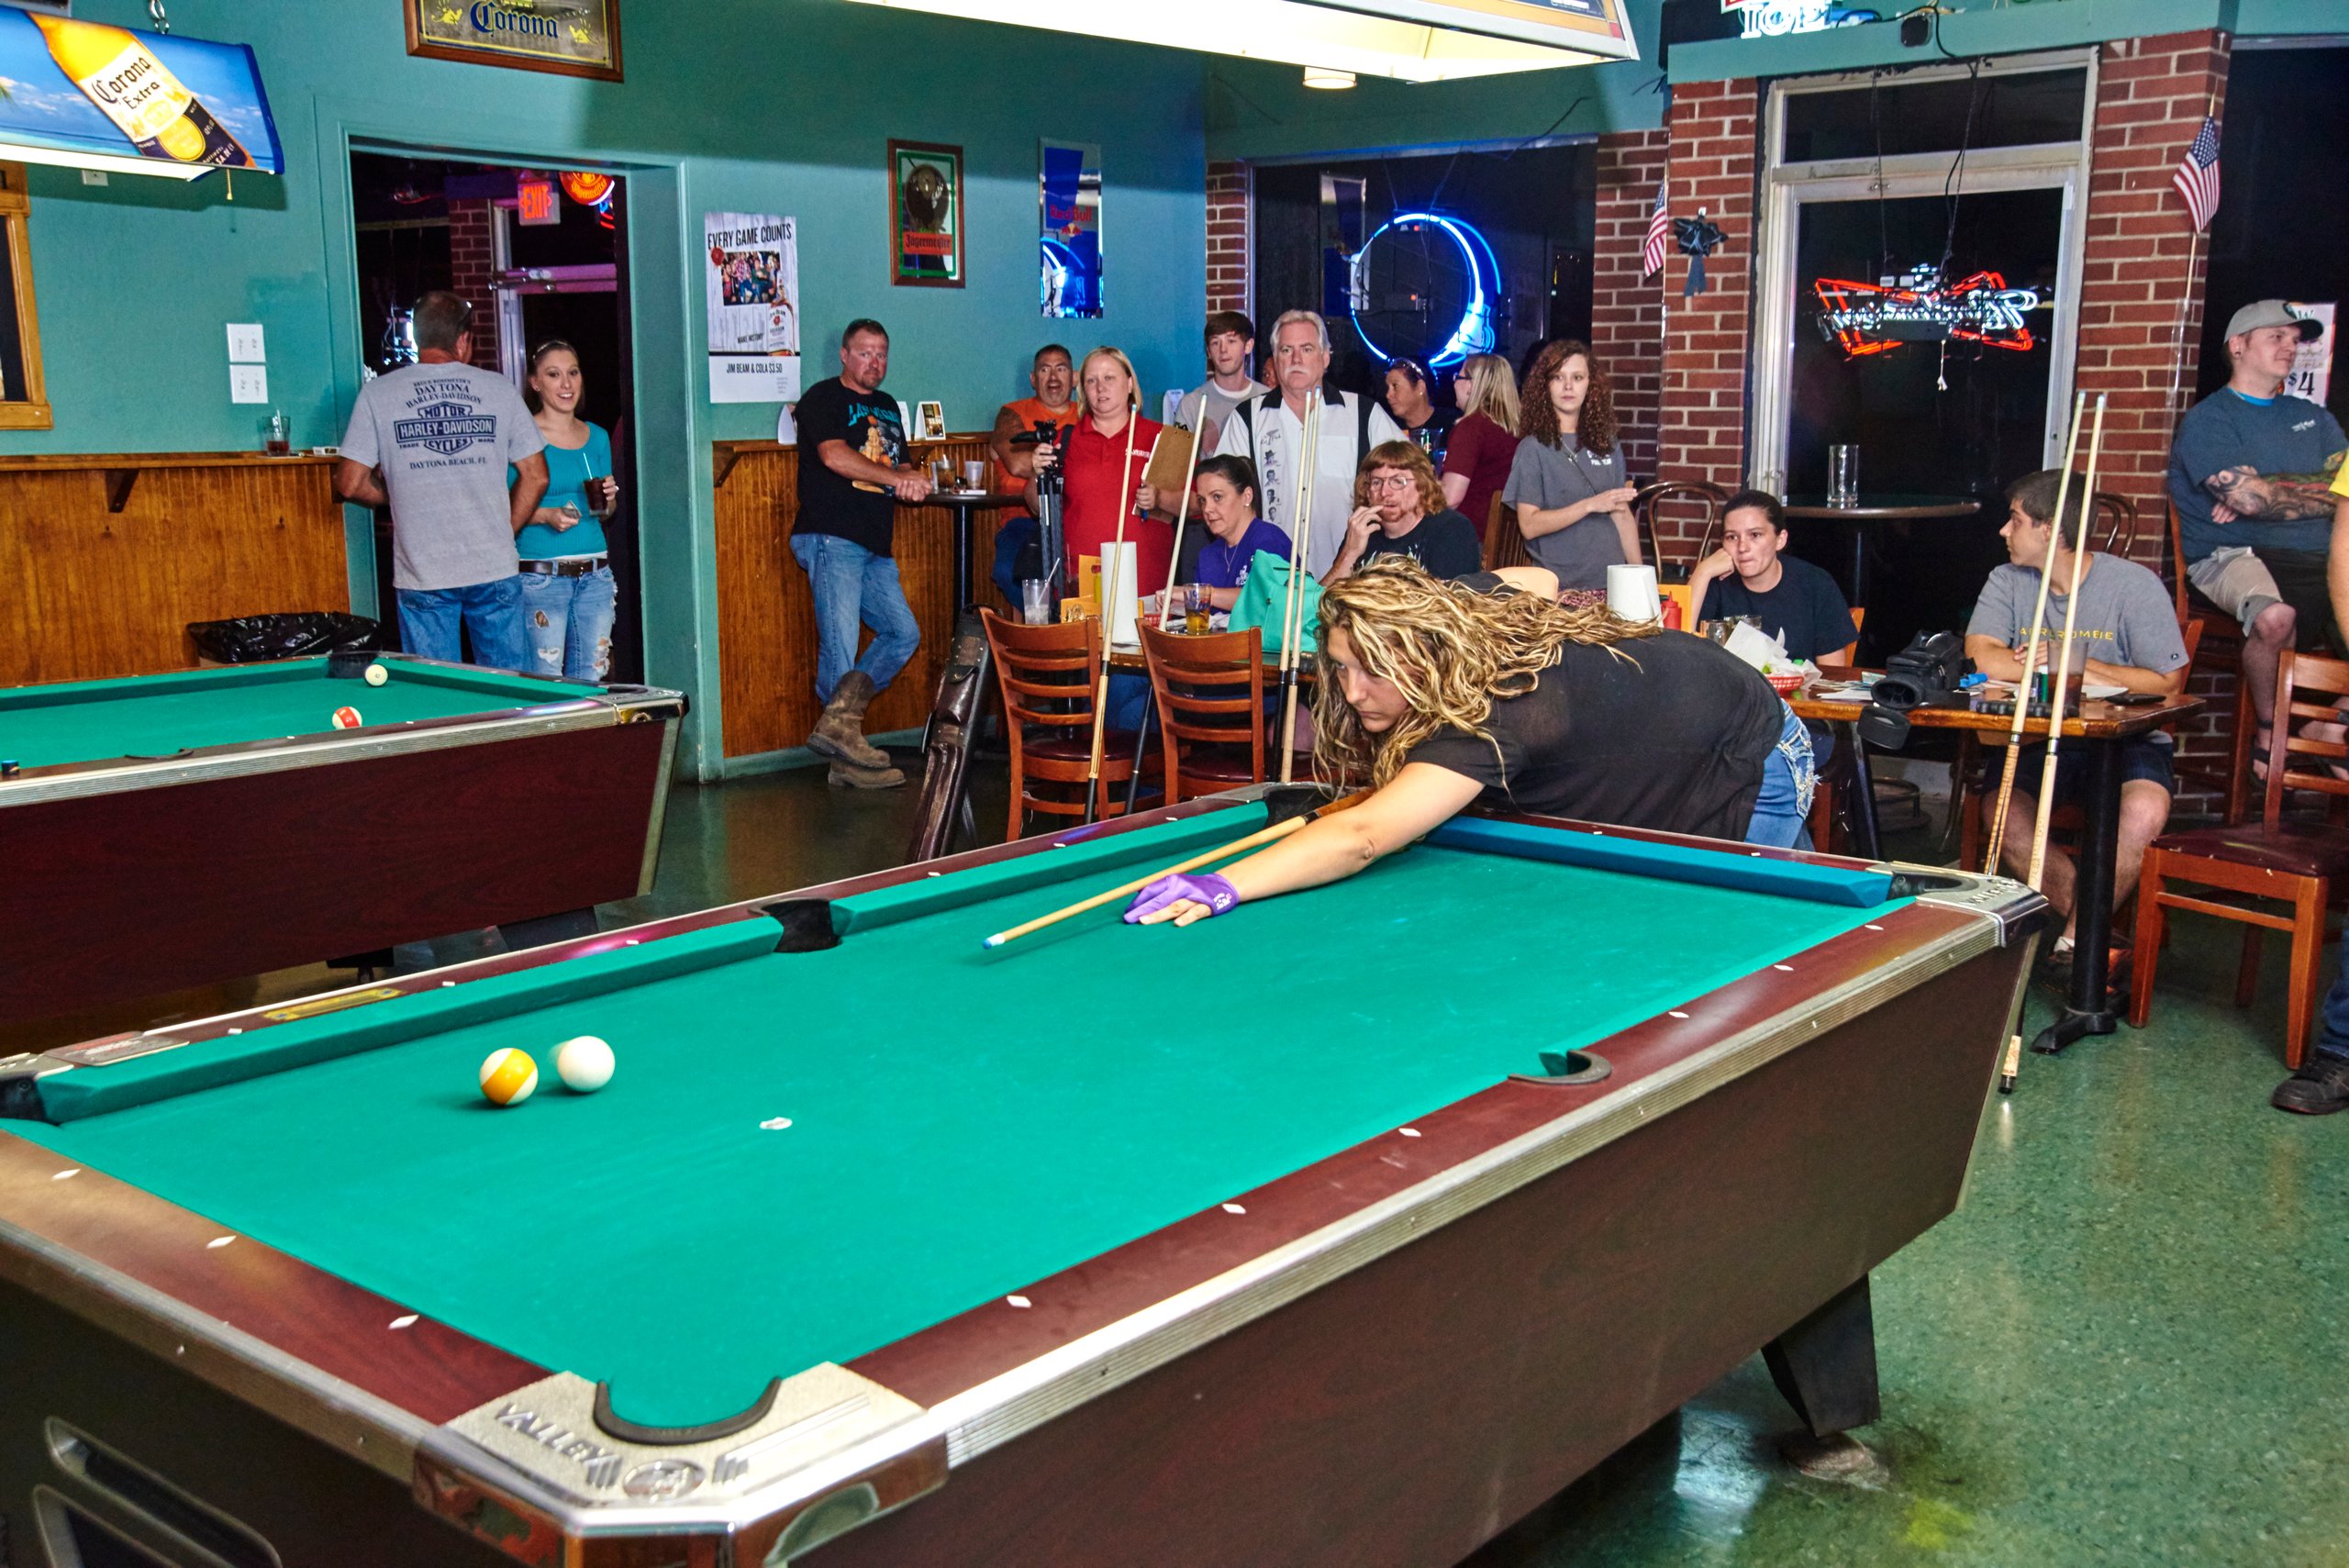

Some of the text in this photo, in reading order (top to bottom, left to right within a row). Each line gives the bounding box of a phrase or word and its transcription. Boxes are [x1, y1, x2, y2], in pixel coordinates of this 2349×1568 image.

[470, 0, 559, 39] Corona
[91, 56, 151, 105] Corona
[123, 81, 161, 110] Extra
[522, 183, 549, 219] EXIT
[1050, 204, 1092, 222] Red Bull
[707, 222, 792, 250] EVERY GAME COUNTS
[726, 363, 736, 373] JIM
[736, 363, 751, 373] BEAM
[755, 363, 768, 373] COLA
[415, 383, 470, 396] DAYTONA
[406, 392, 482, 408] HARLEY-DAVIDSON
[424, 404, 466, 418] MOTOR
[399, 419, 494, 439] HARLEY-DAVIDSON
[428, 438, 469, 452] CYCLES
[409, 460, 448, 470] DAYTONA
[495, 1403, 621, 1468] VALLEY
